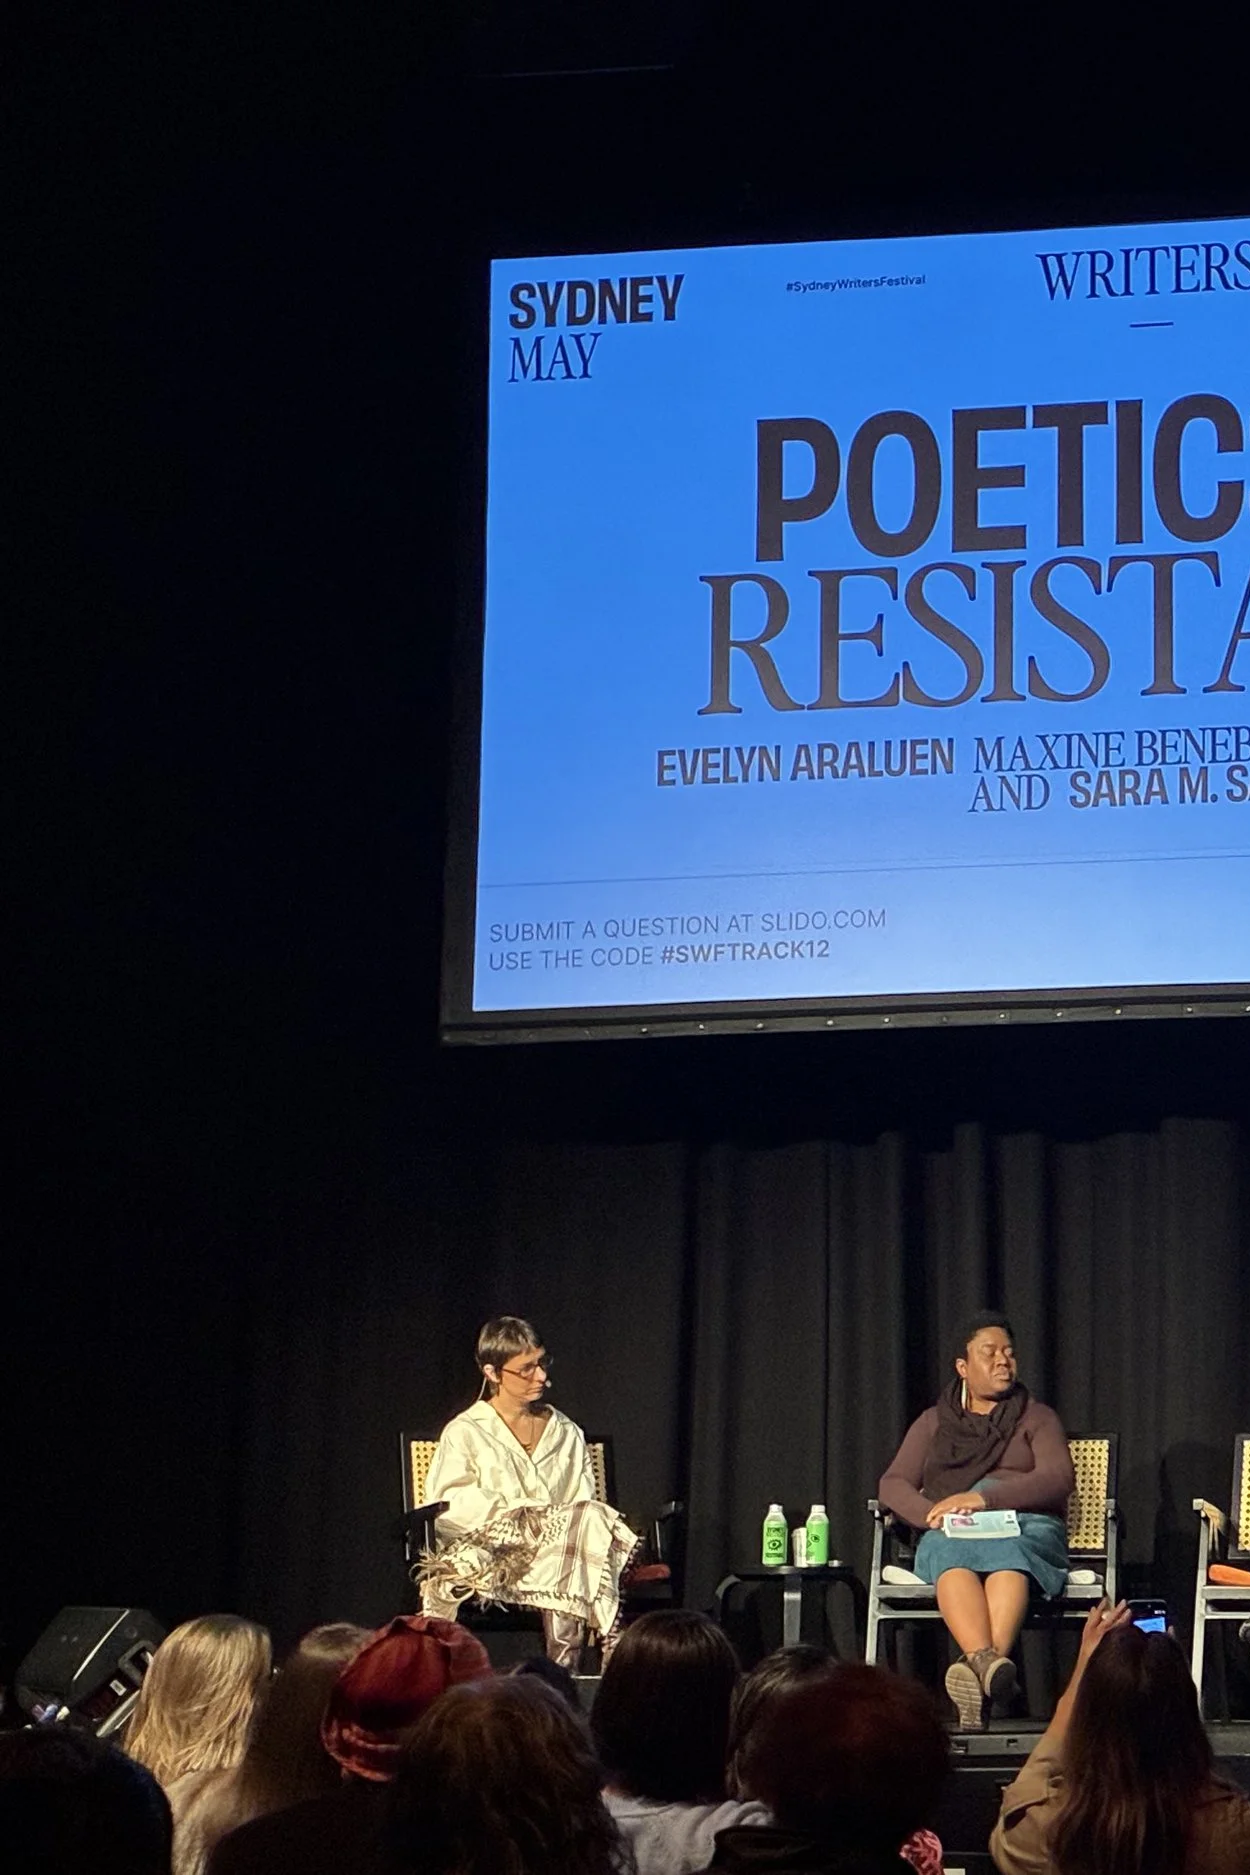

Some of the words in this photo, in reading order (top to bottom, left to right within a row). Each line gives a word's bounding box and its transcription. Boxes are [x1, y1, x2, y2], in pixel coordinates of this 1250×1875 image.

[509, 274, 685, 329] SYDNEY
[786, 274, 926, 294] #SydneyWritersFestival
[507, 332, 602, 383] MAY
[657, 745, 781, 786] EVELYN
[790, 738, 954, 781] ARALUEN
[973, 731, 1125, 773] MAXINE
[968, 774, 1050, 812] AND
[1069, 768, 1169, 808] SARA
[1179, 766, 1218, 803] M.
[490, 921, 575, 943] SUBMIT
[582, 920, 596, 939] A
[604, 915, 720, 939] QUESTION
[726, 914, 754, 934] AT
[762, 909, 887, 932] SLIDO.COM
[489, 951, 532, 971] USE
[542, 949, 583, 969] THE
[591, 946, 653, 967] CODE
[660, 940, 830, 965] #SWFTRACK12
